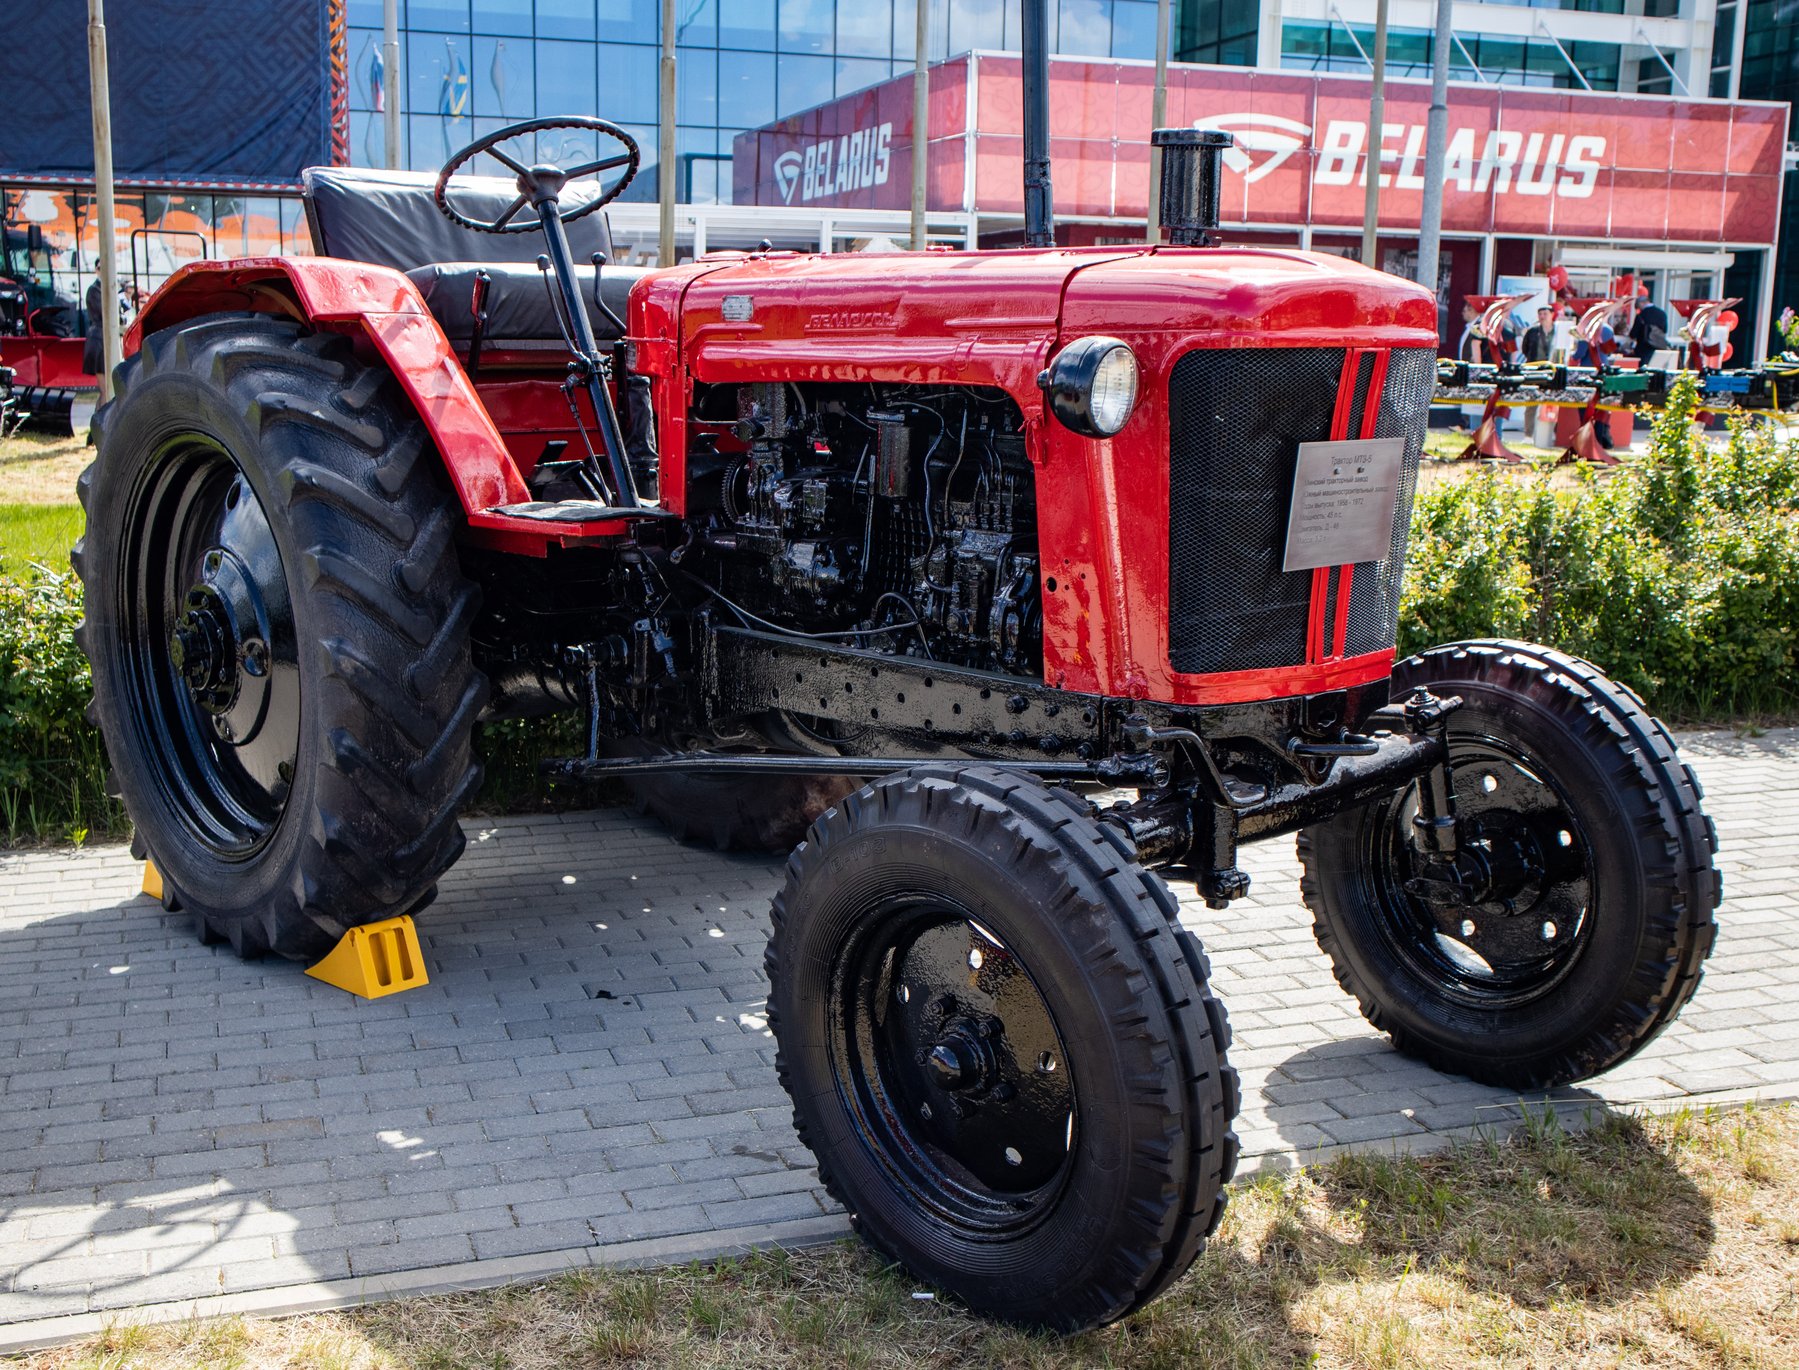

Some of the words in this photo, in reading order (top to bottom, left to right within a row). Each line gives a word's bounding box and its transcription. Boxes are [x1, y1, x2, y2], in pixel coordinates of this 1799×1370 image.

[803, 122, 892, 201] BELARUS
[1314, 120, 1606, 199] BELARUS
[1331, 456, 1353, 466] Трактор
[1354, 454, 1373, 464] МТЗ-5
[1327, 476, 1354, 485] тракторный
[1354, 475, 1369, 483] завод
[1352, 497, 1365, 505] 1972
